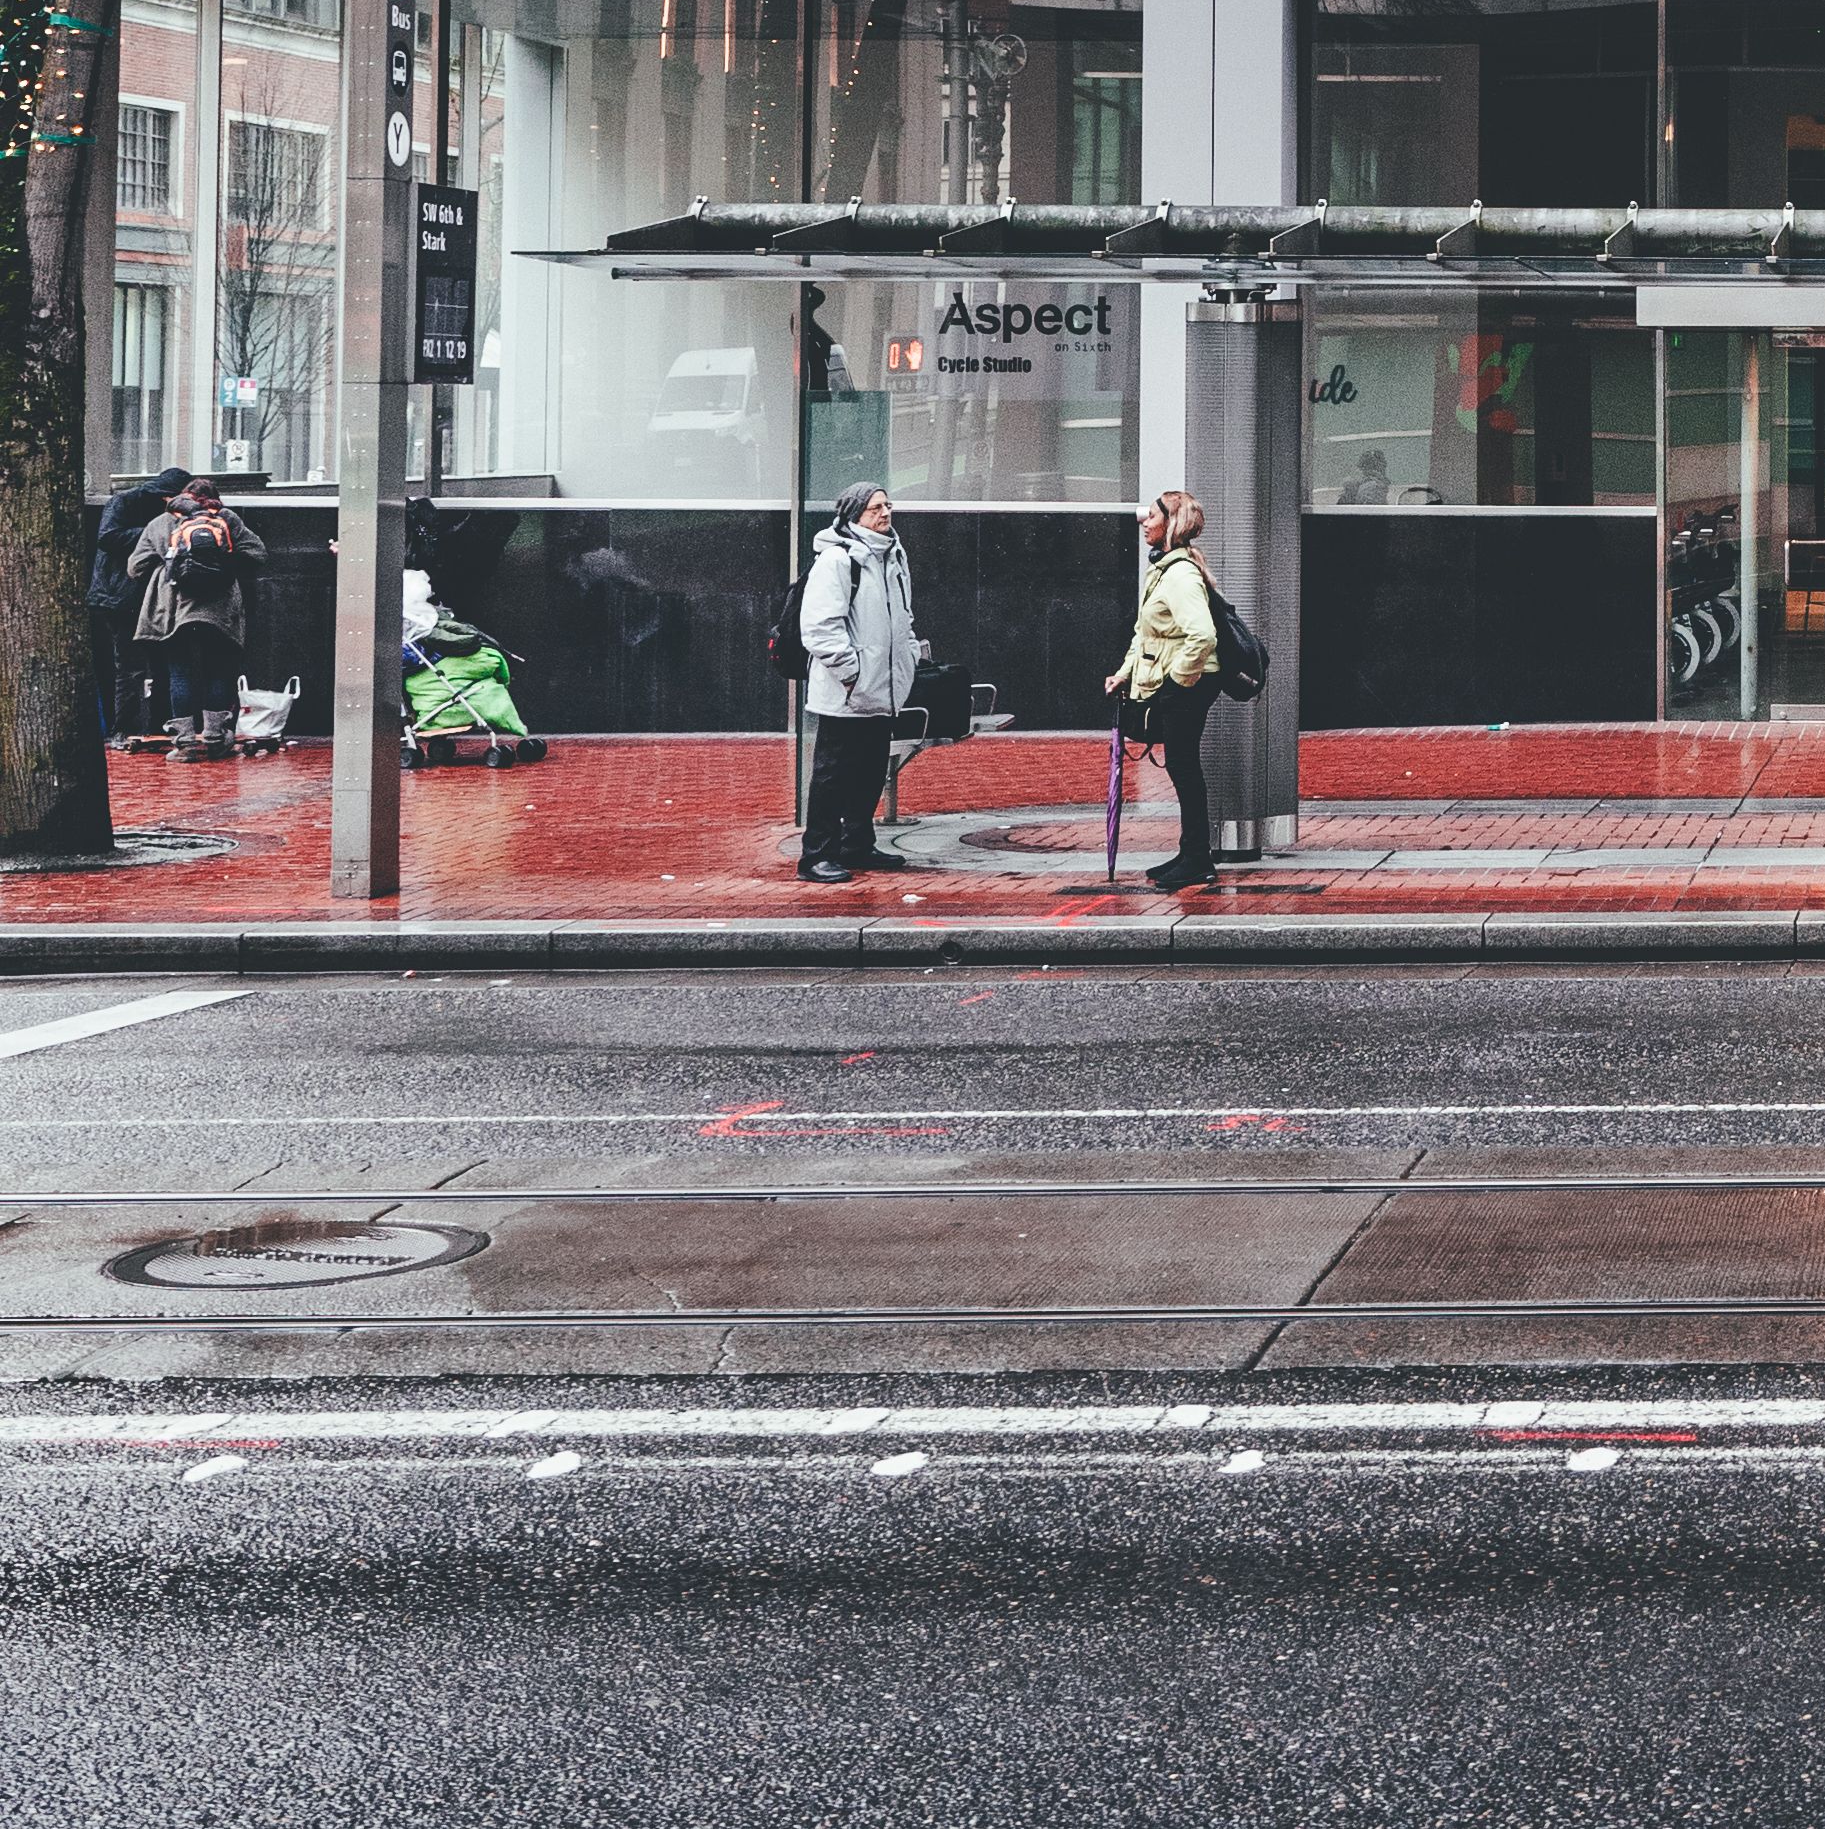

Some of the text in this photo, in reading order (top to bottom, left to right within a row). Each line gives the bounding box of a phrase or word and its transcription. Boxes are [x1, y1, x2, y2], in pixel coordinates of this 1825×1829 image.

[391, 5, 411, 30] Bus
[393, 121, 403, 154] Y
[423, 202, 463, 225] SW 6th &
[422, 230, 446, 251] Stark
[939, 292, 1111, 343] Aspect
[436, 340, 441, 358] 1
[445, 341, 454, 359] 12
[457, 341, 467, 359] 19
[1054, 342, 1111, 352] on Sixth
[938, 356, 1032, 374] Cycle Studio
